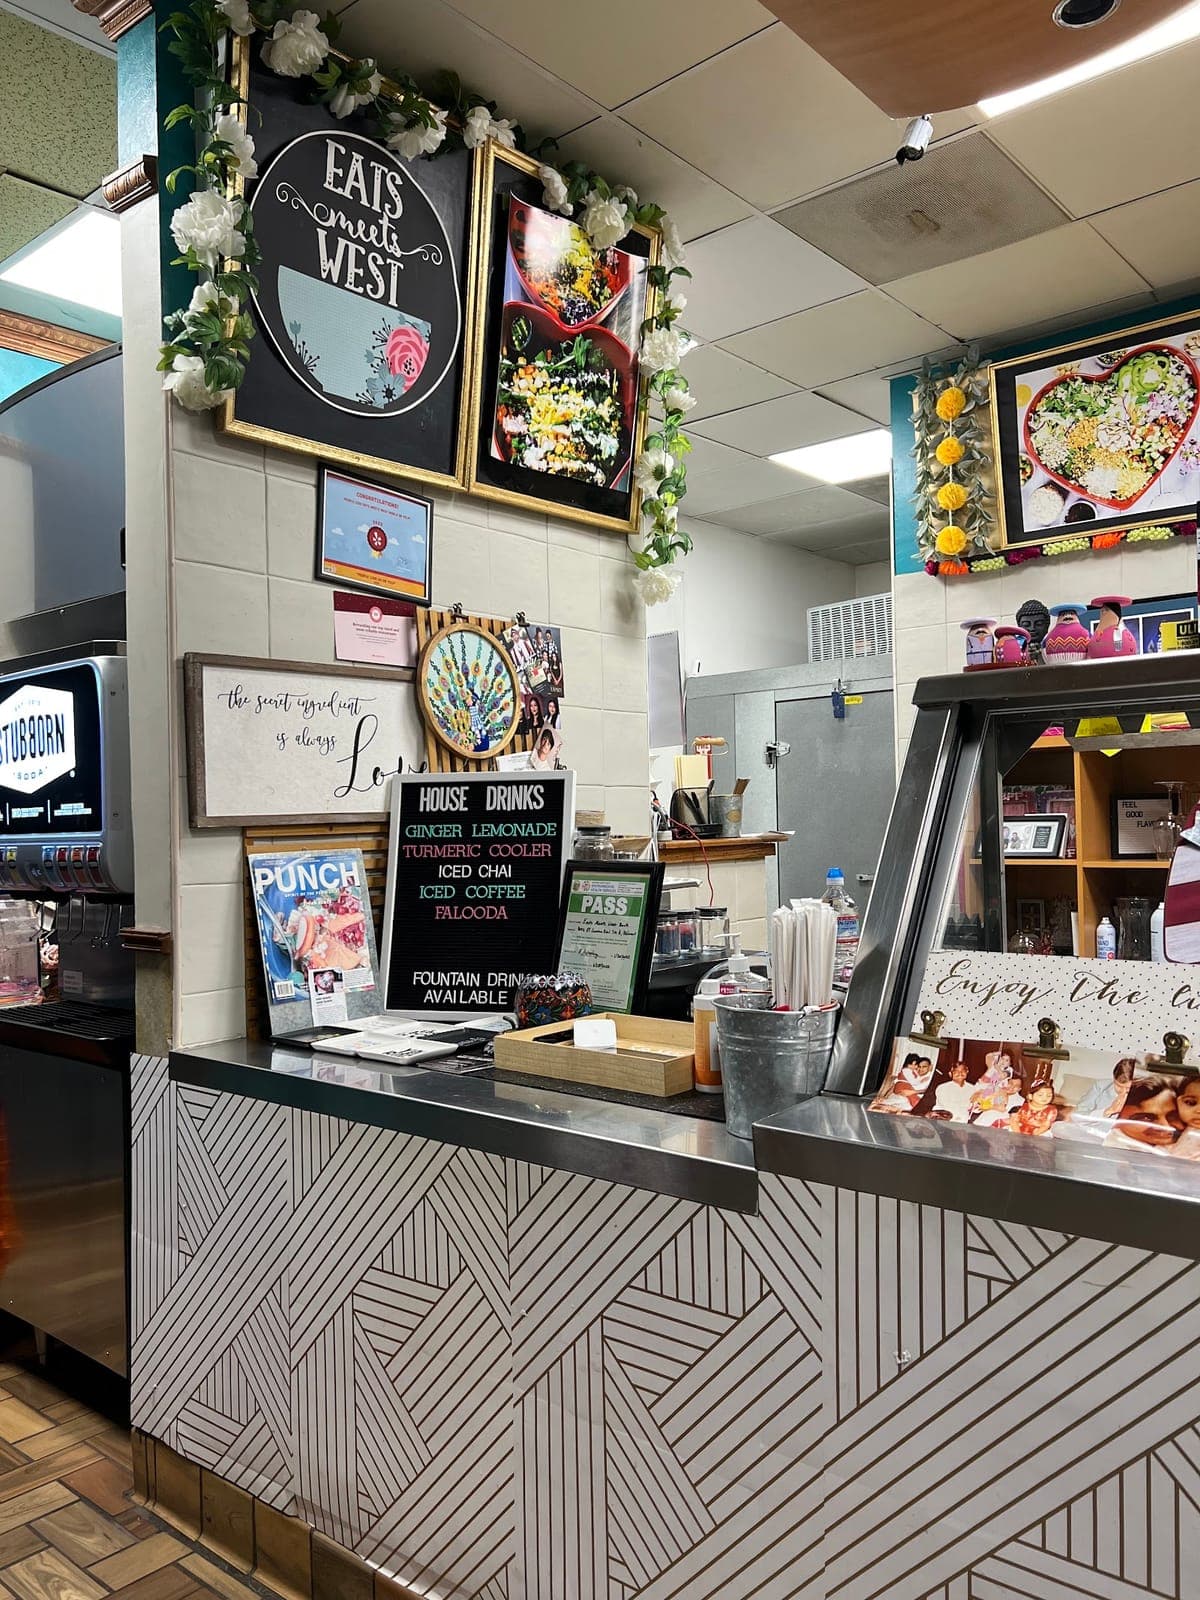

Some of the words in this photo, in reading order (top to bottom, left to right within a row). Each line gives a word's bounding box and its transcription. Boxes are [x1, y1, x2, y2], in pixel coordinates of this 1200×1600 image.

[323, 138, 403, 219] EATS
[316, 228, 403, 307] WEST
[217, 684, 250, 709] the
[255, 692, 300, 713] secret
[297, 690, 374, 719] ingredient
[276, 731, 287, 751] is
[295, 726, 337, 756] always
[419, 786, 469, 812] HOUSE
[485, 785, 545, 811] DRINKS
[405, 824, 462, 838] GINGER
[471, 823, 557, 837] LEMONADE
[402, 844, 481, 858] TURMERIC
[489, 844, 552, 857] COOLER
[254, 861, 360, 894] PUNCH
[438, 864, 472, 878] ICED
[478, 864, 512, 878] CHAI
[419, 885, 456, 899] ICED
[465, 885, 526, 899] COFFEE
[434, 905, 508, 920] FALOODA
[581, 895, 629, 915] PASS
[413, 971, 480, 987] FOUNTAIN
[936, 958, 1053, 1015] Enjoy
[423, 990, 508, 1005] AVAILABLE
